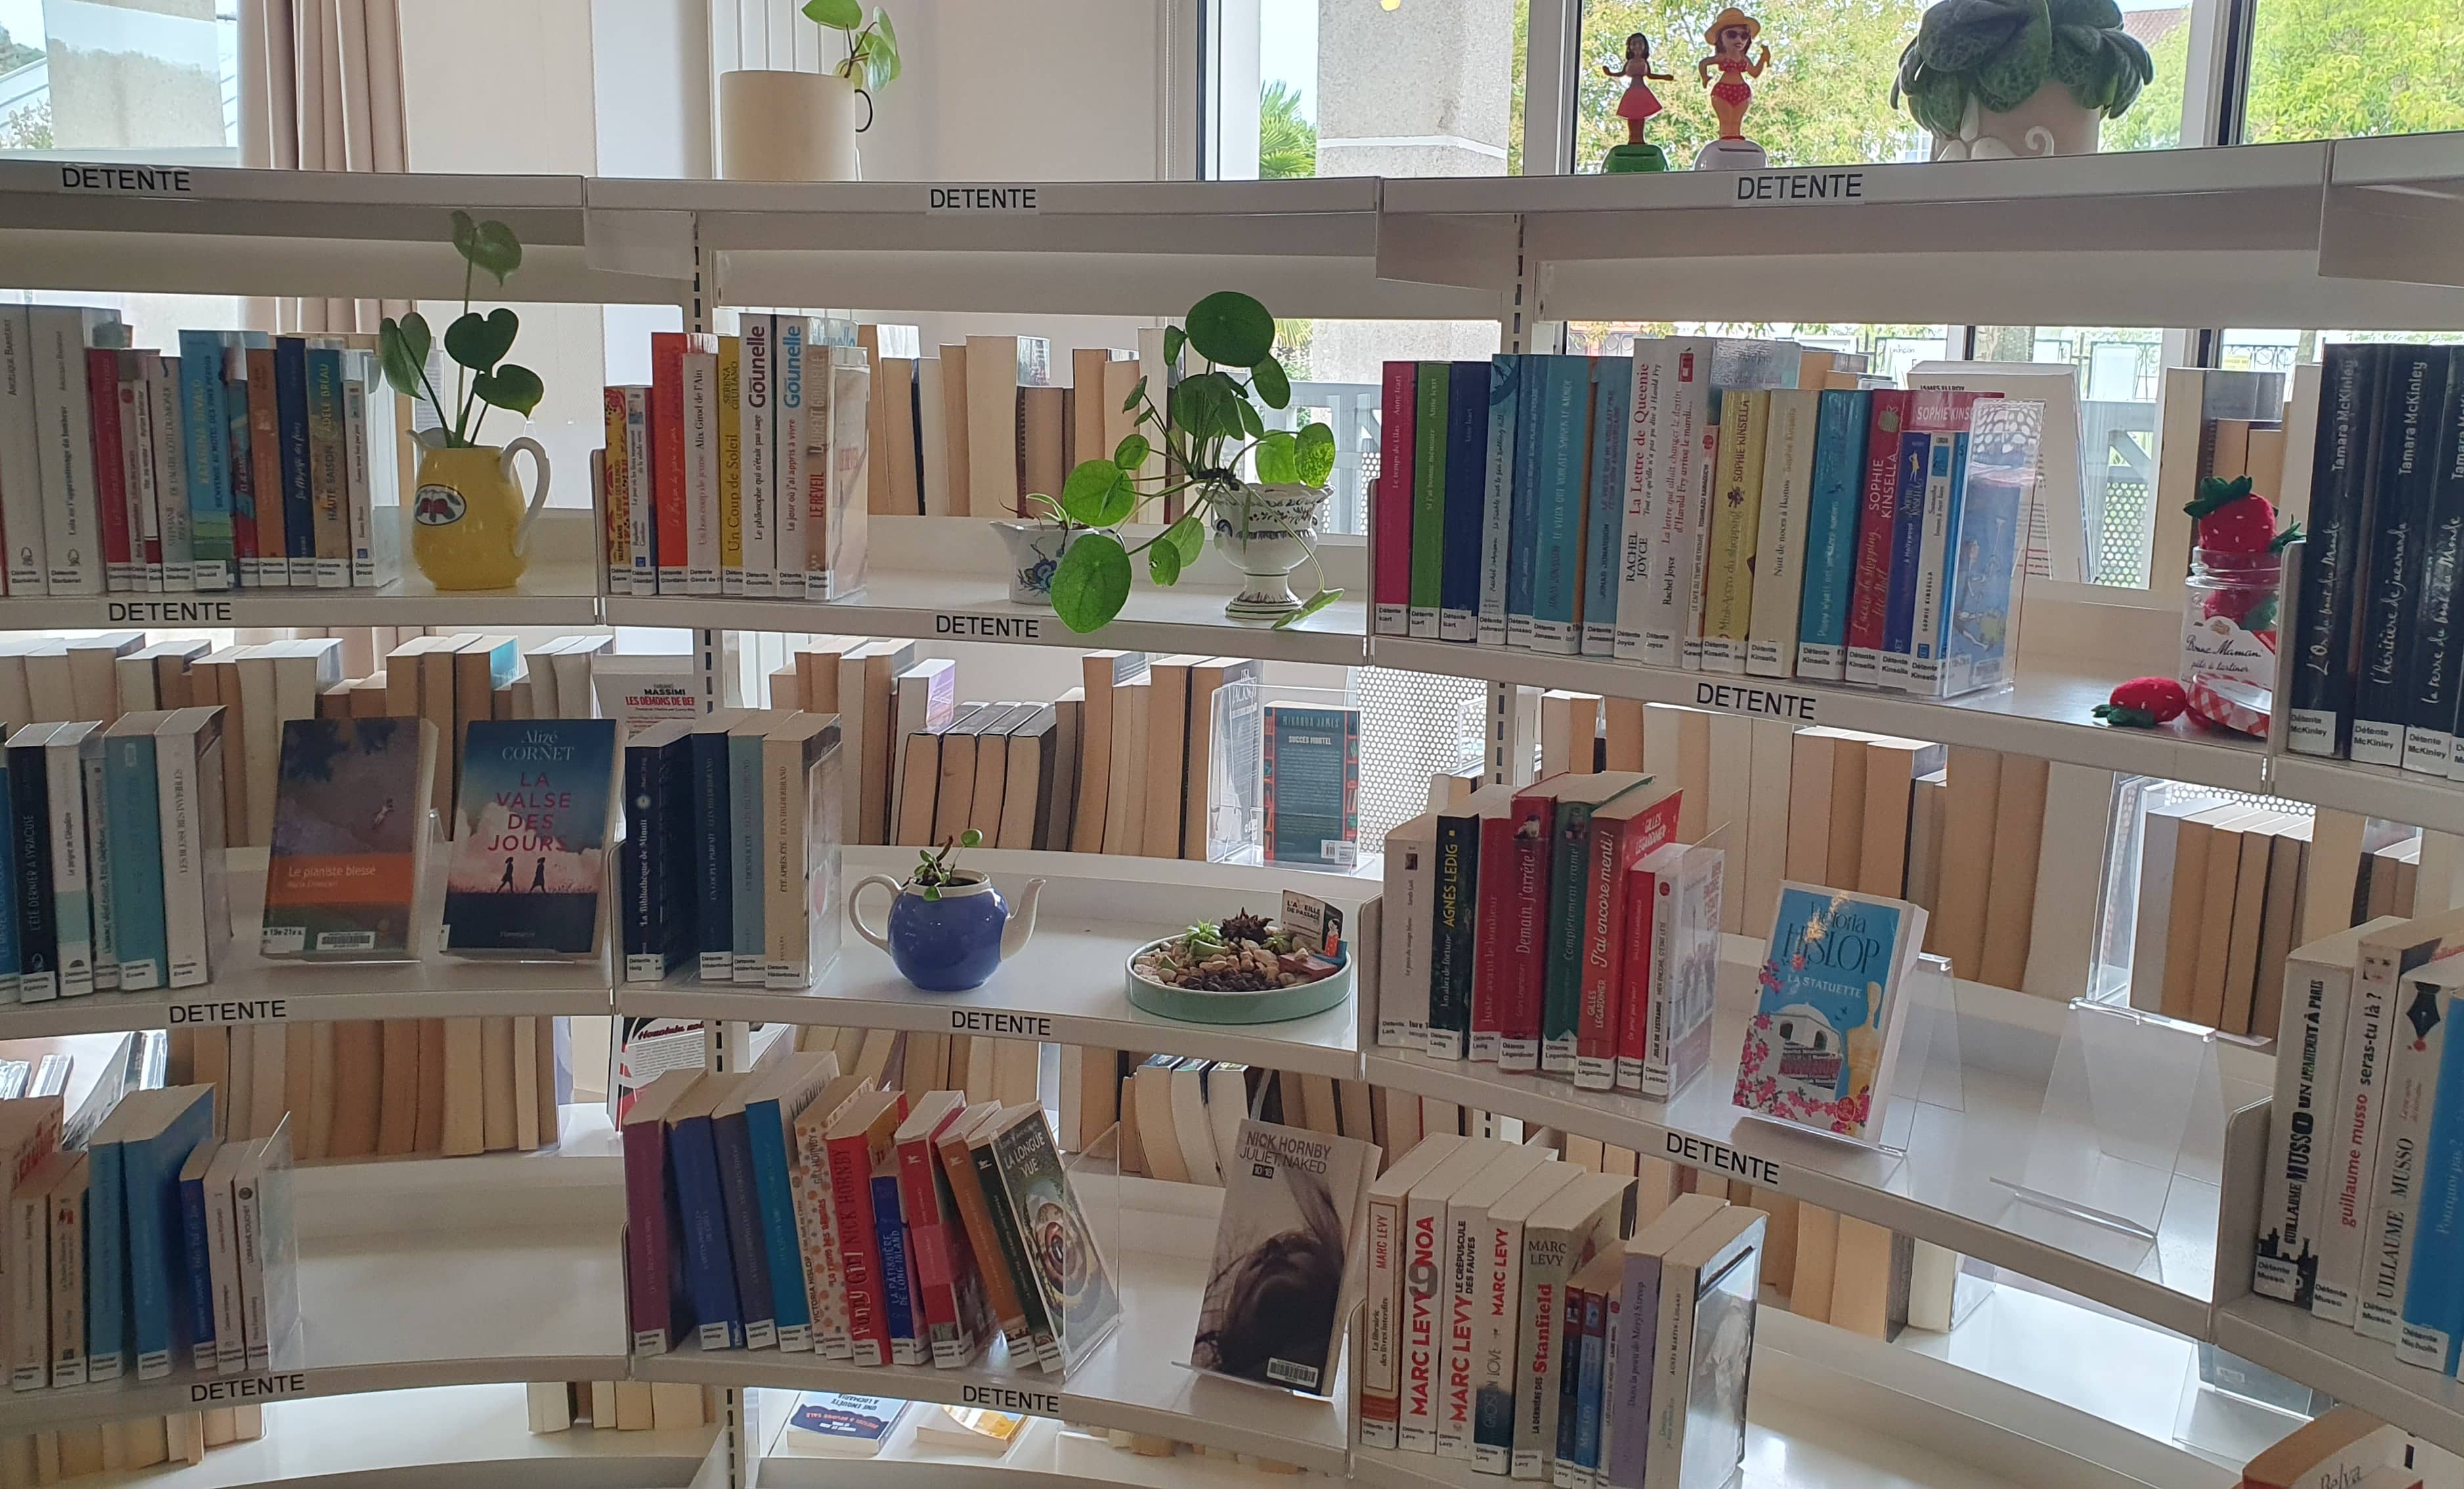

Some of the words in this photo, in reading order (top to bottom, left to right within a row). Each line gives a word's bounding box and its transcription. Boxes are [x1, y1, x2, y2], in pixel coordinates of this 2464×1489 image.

[61, 167, 191, 191] DETENTE
[1738, 174, 1863, 200] DETENTE
[931, 189, 1036, 208] DETENTE
[746, 326, 767, 408] Gounelle
[783, 326, 802, 408] Gounelle
[693, 370, 704, 391] l'Ain
[722, 367, 731, 404] SERENA
[730, 360, 740, 410] GIULIANO
[1633, 364, 1649, 423] Queenie
[2338, 359, 2357, 421] McKinley
[2404, 361, 2427, 424] McKinley
[695, 393, 704, 404] de
[694, 406, 704, 429] Girod
[754, 414, 764, 431] sage
[1735, 400, 1750, 445] KINSELLA
[694, 432, 704, 450] Alix
[754, 433, 763, 446] pas
[1632, 429, 1645, 446] de
[2331, 424, 2348, 471] Tamara
[725, 434, 739, 468] Soleil
[752, 448, 762, 471] n'était
[2398, 427, 2417, 475] Tamara
[1630, 452, 1644, 494] Lettre
[1733, 448, 1746, 483] SOPHIE
[725, 472, 739, 488] de
[753, 473, 764, 485] qui
[808, 472, 825, 504] RÉVEIL
[1868, 460, 1884, 510] SOPHIE
[1880, 452, 1898, 519] KINSELLA
[727, 494, 741, 529] Coup
[753, 487, 766, 529] philosophe
[810, 506, 824, 518] LE
[1628, 499, 1641, 515] La
[728, 532, 740, 551] Un
[754, 530, 763, 540] Le
[1777, 517, 1786, 542] noces
[1625, 531, 1637, 582] RACHEL
[1637, 538, 1649, 578] JOYCE
[1775, 544, 1785, 555] de
[1664, 556, 1675, 577] Joyce
[1773, 557, 1784, 577] Nuit
[1662, 579, 1674, 605] Rachel
[108, 602, 231, 622] DETENTE
[937, 615, 1039, 637] DETENTE
[2186, 634, 2211, 655] Bonne
[2211, 639, 2261, 657] Maman
[1882, 666, 1908, 674] Kinsella
[626, 696, 639, 706] LES
[672, 697, 681, 706] DE
[1698, 683, 1816, 720] DETENTE
[521, 729, 558, 747] Alizé
[2291, 725, 2327, 737] McKinley
[2354, 737, 2394, 750] McKinley
[2355, 725, 2389, 736] Détente
[2410, 734, 2442, 745] Détente
[502, 745, 574, 762] CORNET
[2408, 745, 2447, 759] McKinley
[520, 771, 550, 787] LA
[495, 792, 571, 808] VALSE
[508, 813, 553, 831] DES
[639, 819, 648, 848] Minuit
[488, 834, 568, 852] JOURS
[639, 850, 648, 859] de
[288, 865, 302, 877] Le
[303, 866, 343, 878] pianiste
[345, 863, 378, 876] blessé
[1442, 844, 1458, 882] LEDIG
[1599, 840, 1613, 882] menti
[639, 861, 650, 913] Bibliothèque
[1286, 899, 1321, 915] L'AEILLE
[1440, 885, 1458, 928] AGNÈS
[1595, 884, 1611, 934] encore
[639, 915, 648, 926] La
[1516, 906, 1532, 954] Demain
[1787, 974, 1801, 985] LA
[1802, 976, 1863, 999] STATUETTE
[2308, 979, 2324, 1010] PARIS
[169, 1000, 286, 1024] DETENTE
[1587, 990, 1597, 1016] GILLES
[1595, 979, 1607, 1029] LEGARDINIER
[2363, 1004, 2381, 1019] là
[951, 1012, 1051, 1036] DETENTE
[2302, 1012, 2321, 1024] À
[2301, 1024, 2320, 1082] APPARTEMENT
[2357, 1022, 2377, 1087] seras-tu
[2295, 1084, 2312, 1108] UN
[2350, 1093, 2368, 1145] musso
[1004, 1153, 1016, 1169] LA
[1014, 1132, 1045, 1162] LONGUE
[1247, 1131, 1276, 1148] NICK
[1280, 1137, 1331, 1160] HORNBY
[1667, 1132, 1780, 1184] DETENTE
[2285, 1111, 2314, 1180] MUSSO
[833, 1149, 857, 1204] HORNBY
[1020, 1158, 1039, 1176] VUE
[1282, 1157, 1327, 1175] NAKED
[2390, 1137, 2415, 1198] MUSSO
[2338, 1150, 2362, 1228] guillaume
[1376, 1214, 1389, 1239] LEVY
[2284, 1182, 2304, 1245] GUILLAUME
[841, 1210, 860, 1245] NICK
[891, 1230, 904, 1262] ISLAND
[1414, 1216, 1435, 1266] NOA
[1454, 1220, 1467, 1280] CRÉPUSCULE
[1494, 1228, 1509, 1268] LEVY
[1529, 1240, 1567, 1254] MARC
[844, 1251, 869, 1284] Girl
[1375, 1241, 1387, 1269] MARC
[1464, 1236, 1476, 1274] FAUVES
[1530, 1254, 1563, 1266] LEVY
[2258, 1261, 2291, 1274] Détente
[2376, 1209, 2405, 1300] UILLAUME
[804, 1256, 814, 1284] HISLOP
[896, 1266, 907, 1291] LONG
[2257, 1271, 2285, 1284] Musso
[1455, 1282, 1464, 1293] LE
[1464, 1276, 1474, 1294] DES
[1491, 1271, 1506, 1316] MARC
[2315, 1283, 2348, 1299] Détente
[808, 1285, 821, 1324] VICTORIA
[846, 1289, 871, 1335] Funny
[899, 1294, 909, 1306] DE
[2314, 1294, 2342, 1307] Musso
[1412, 1290, 1431, 1346] LEVY
[1452, 1295, 1473, 1352] LEVY
[1532, 1283, 1553, 1374] Stanfield
[2362, 1312, 2392, 1326] Musso
[191, 1375, 305, 1402] DETENTE
[1409, 1350, 1431, 1416] MARC
[1449, 1357, 1470, 1423] MARC
[1534, 1377, 1544, 1390] DES
[964, 1385, 1058, 1413] DETENTE
[1531, 1391, 1543, 1424] DERNIÈRE
[1532, 1425, 1541, 1434] LA
